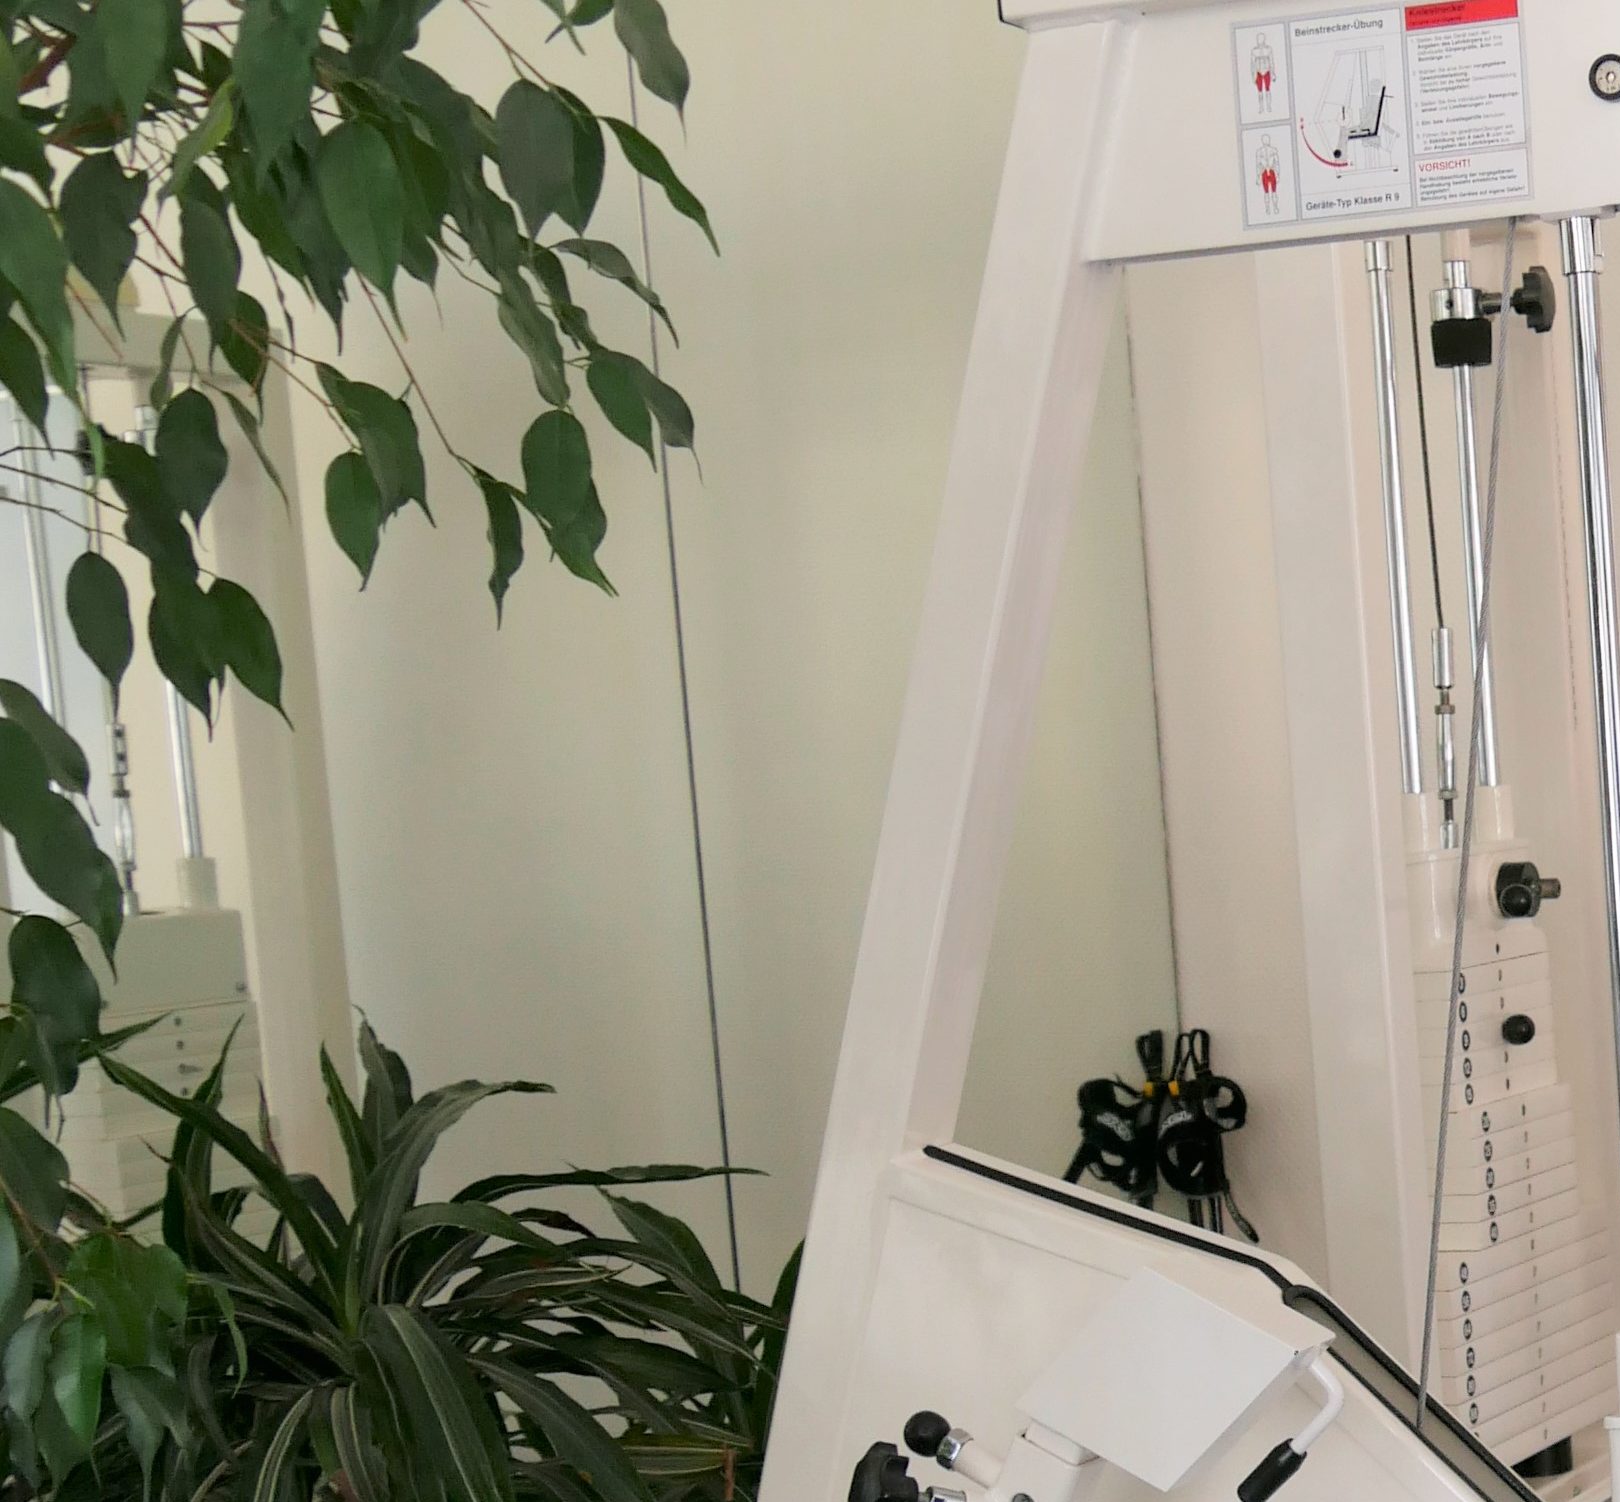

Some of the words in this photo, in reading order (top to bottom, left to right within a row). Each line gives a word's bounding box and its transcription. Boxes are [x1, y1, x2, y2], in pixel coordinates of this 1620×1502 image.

[1295, 18, 1383, 37] Beinstrecker-Übung
[1419, 159, 1471, 172] VORSICHT!
[1306, 198, 1352, 211] Geräte-Typ
[1354, 195, 1383, 205] Klasse
[1385, 193, 1392, 201] R
[1394, 192, 1400, 200] 9
